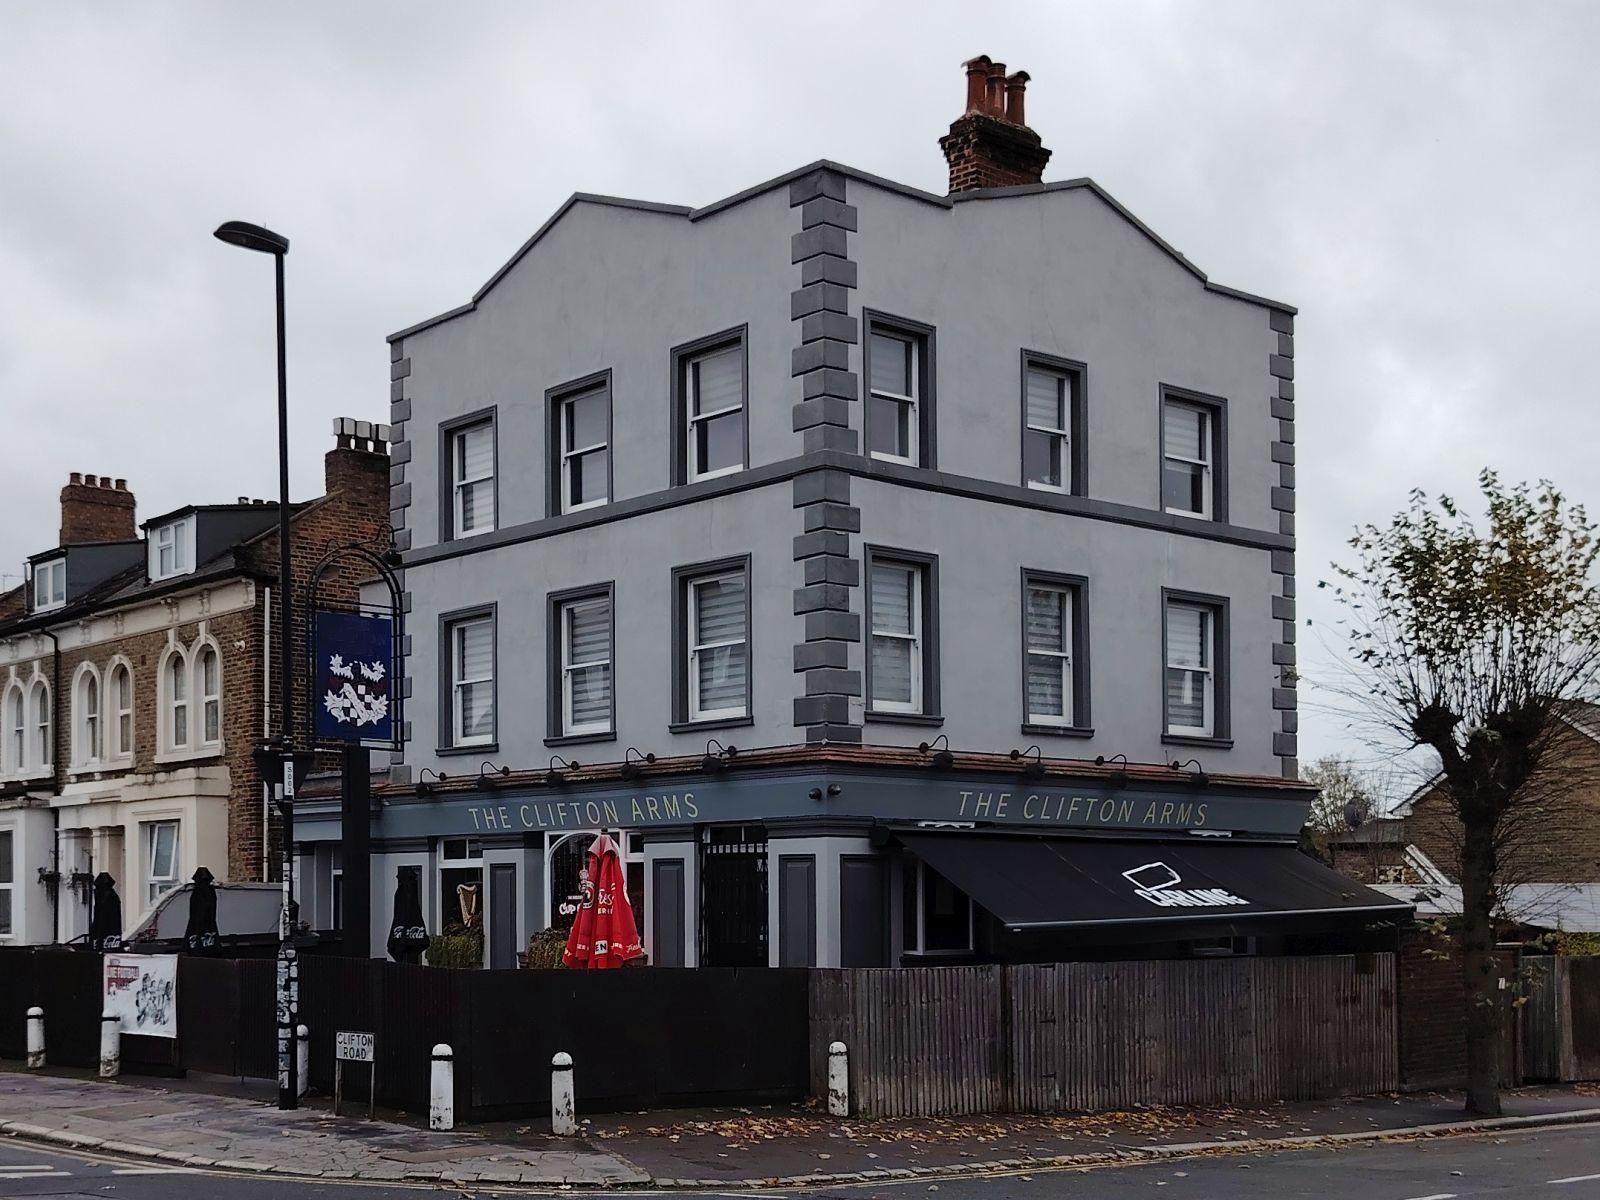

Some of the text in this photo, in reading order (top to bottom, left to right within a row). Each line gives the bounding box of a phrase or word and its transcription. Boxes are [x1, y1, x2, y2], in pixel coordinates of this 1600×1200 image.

[468, 793, 699, 830] THE CLIFTON ARMS
[959, 791, 1209, 827] THE CLIFTON ARMS
[337, 1033, 373, 1047] CLIFTON
[343, 1046, 367, 1060] ROAD
